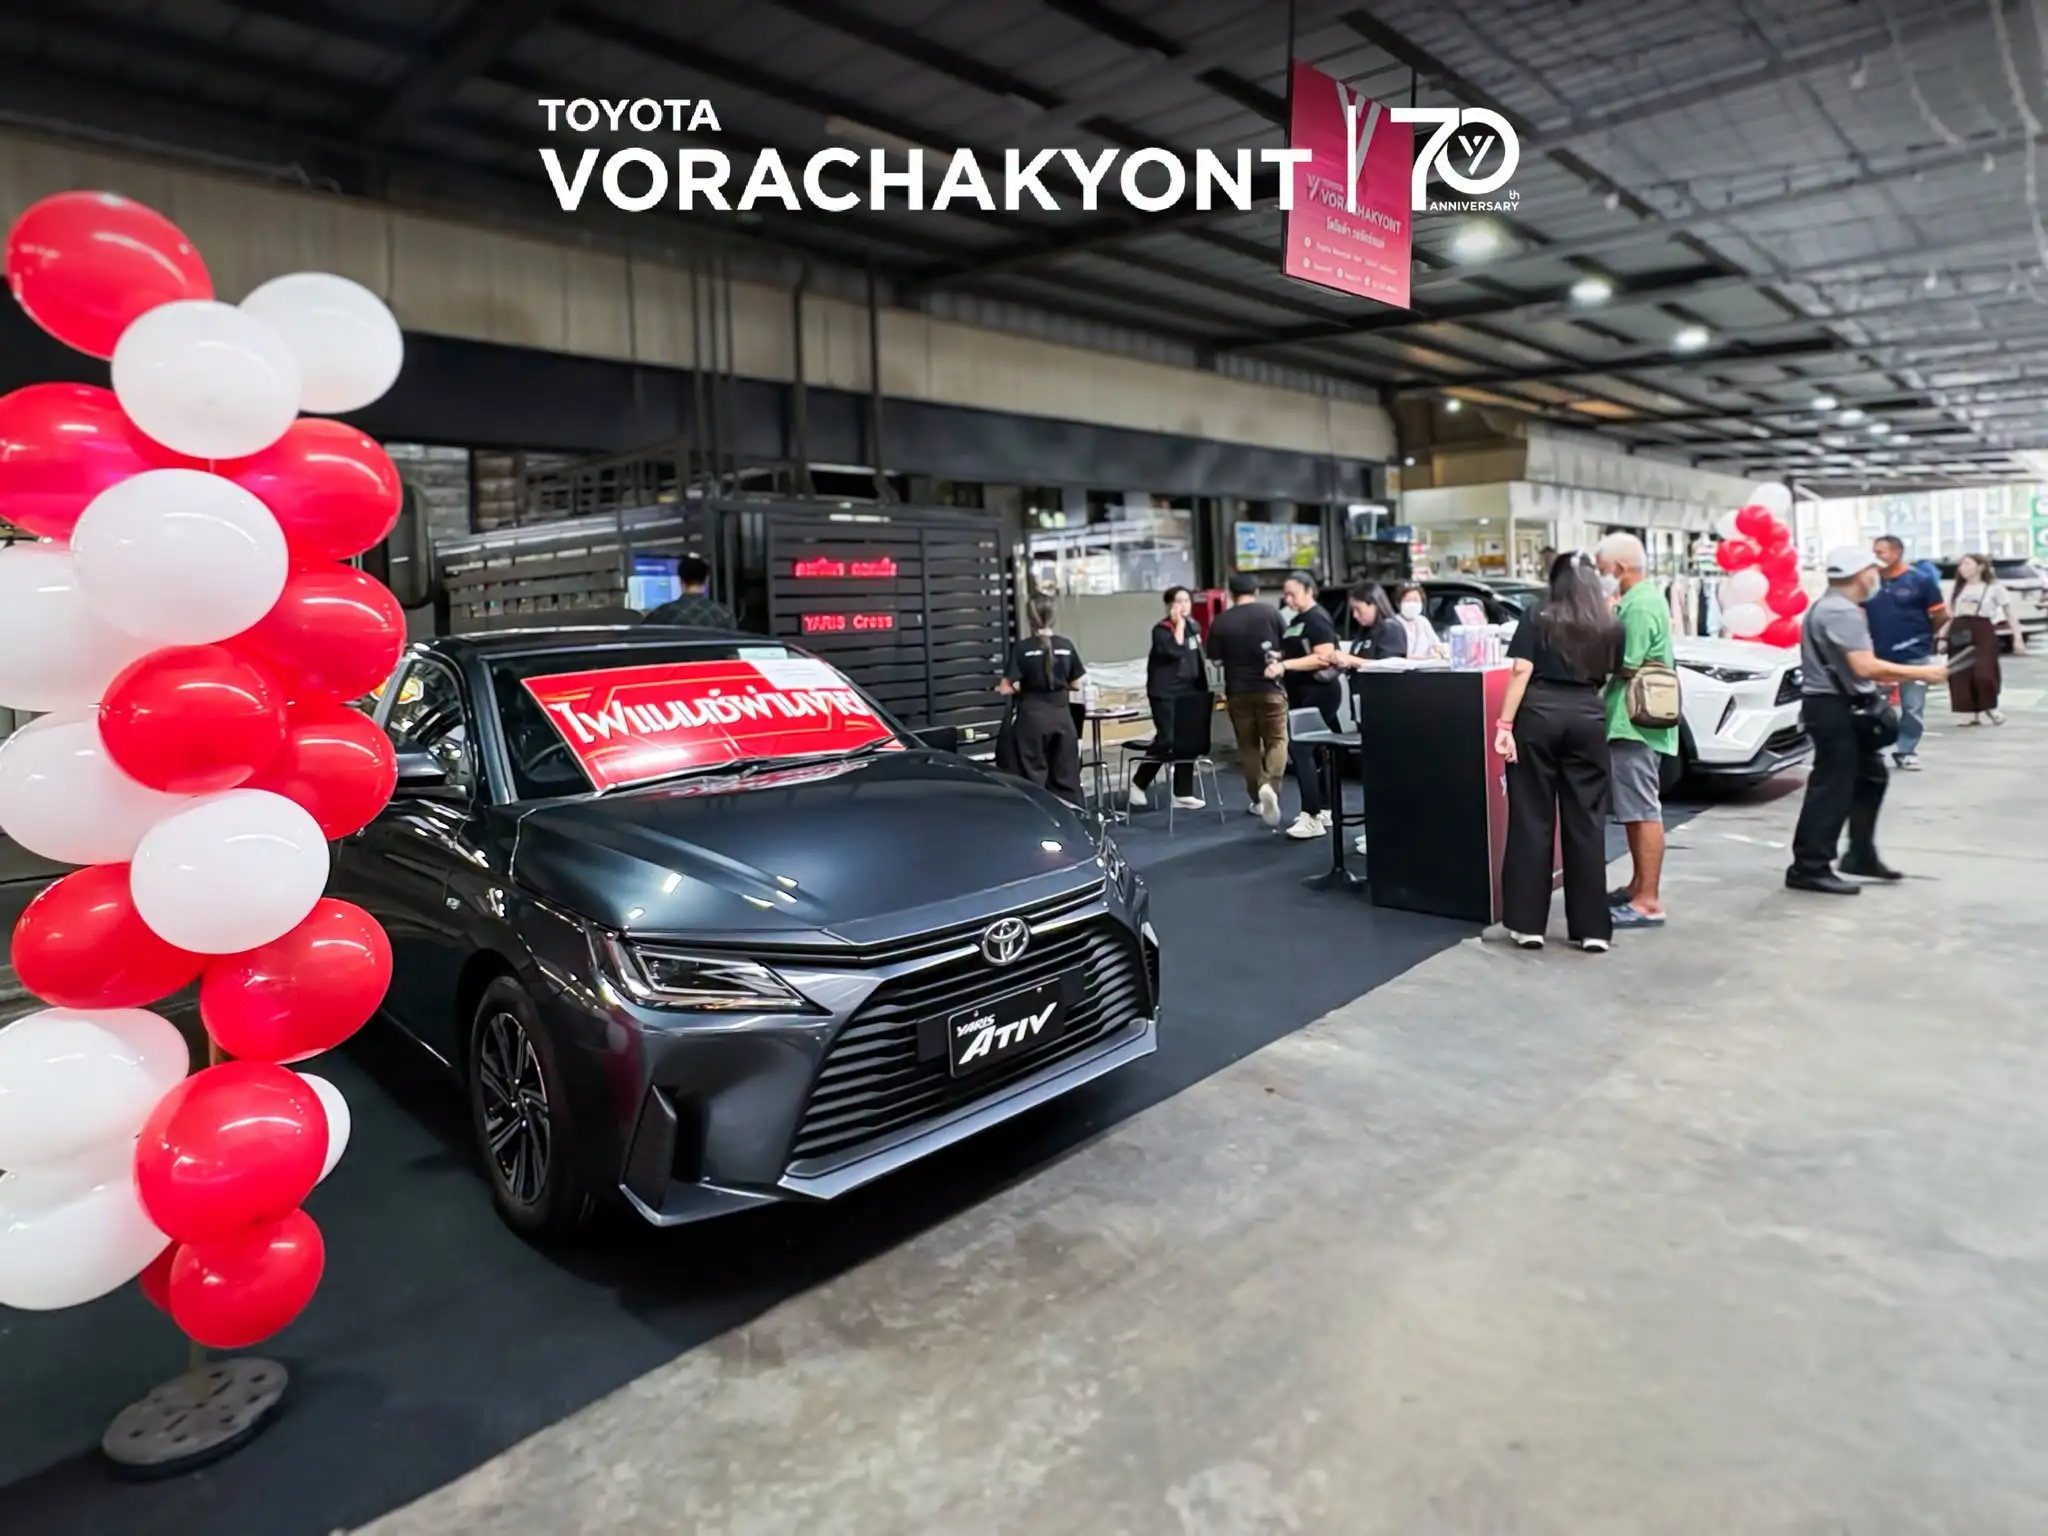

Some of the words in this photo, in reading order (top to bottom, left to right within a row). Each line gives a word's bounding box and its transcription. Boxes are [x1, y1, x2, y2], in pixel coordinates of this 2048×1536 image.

[1321, 187, 1403, 236] VORHAKYONT
[804, 615, 845, 632] YARIS
[852, 614, 892, 630] Cross
[956, 1013, 996, 1038] YARIS
[958, 1001, 1058, 1065] ATIV
